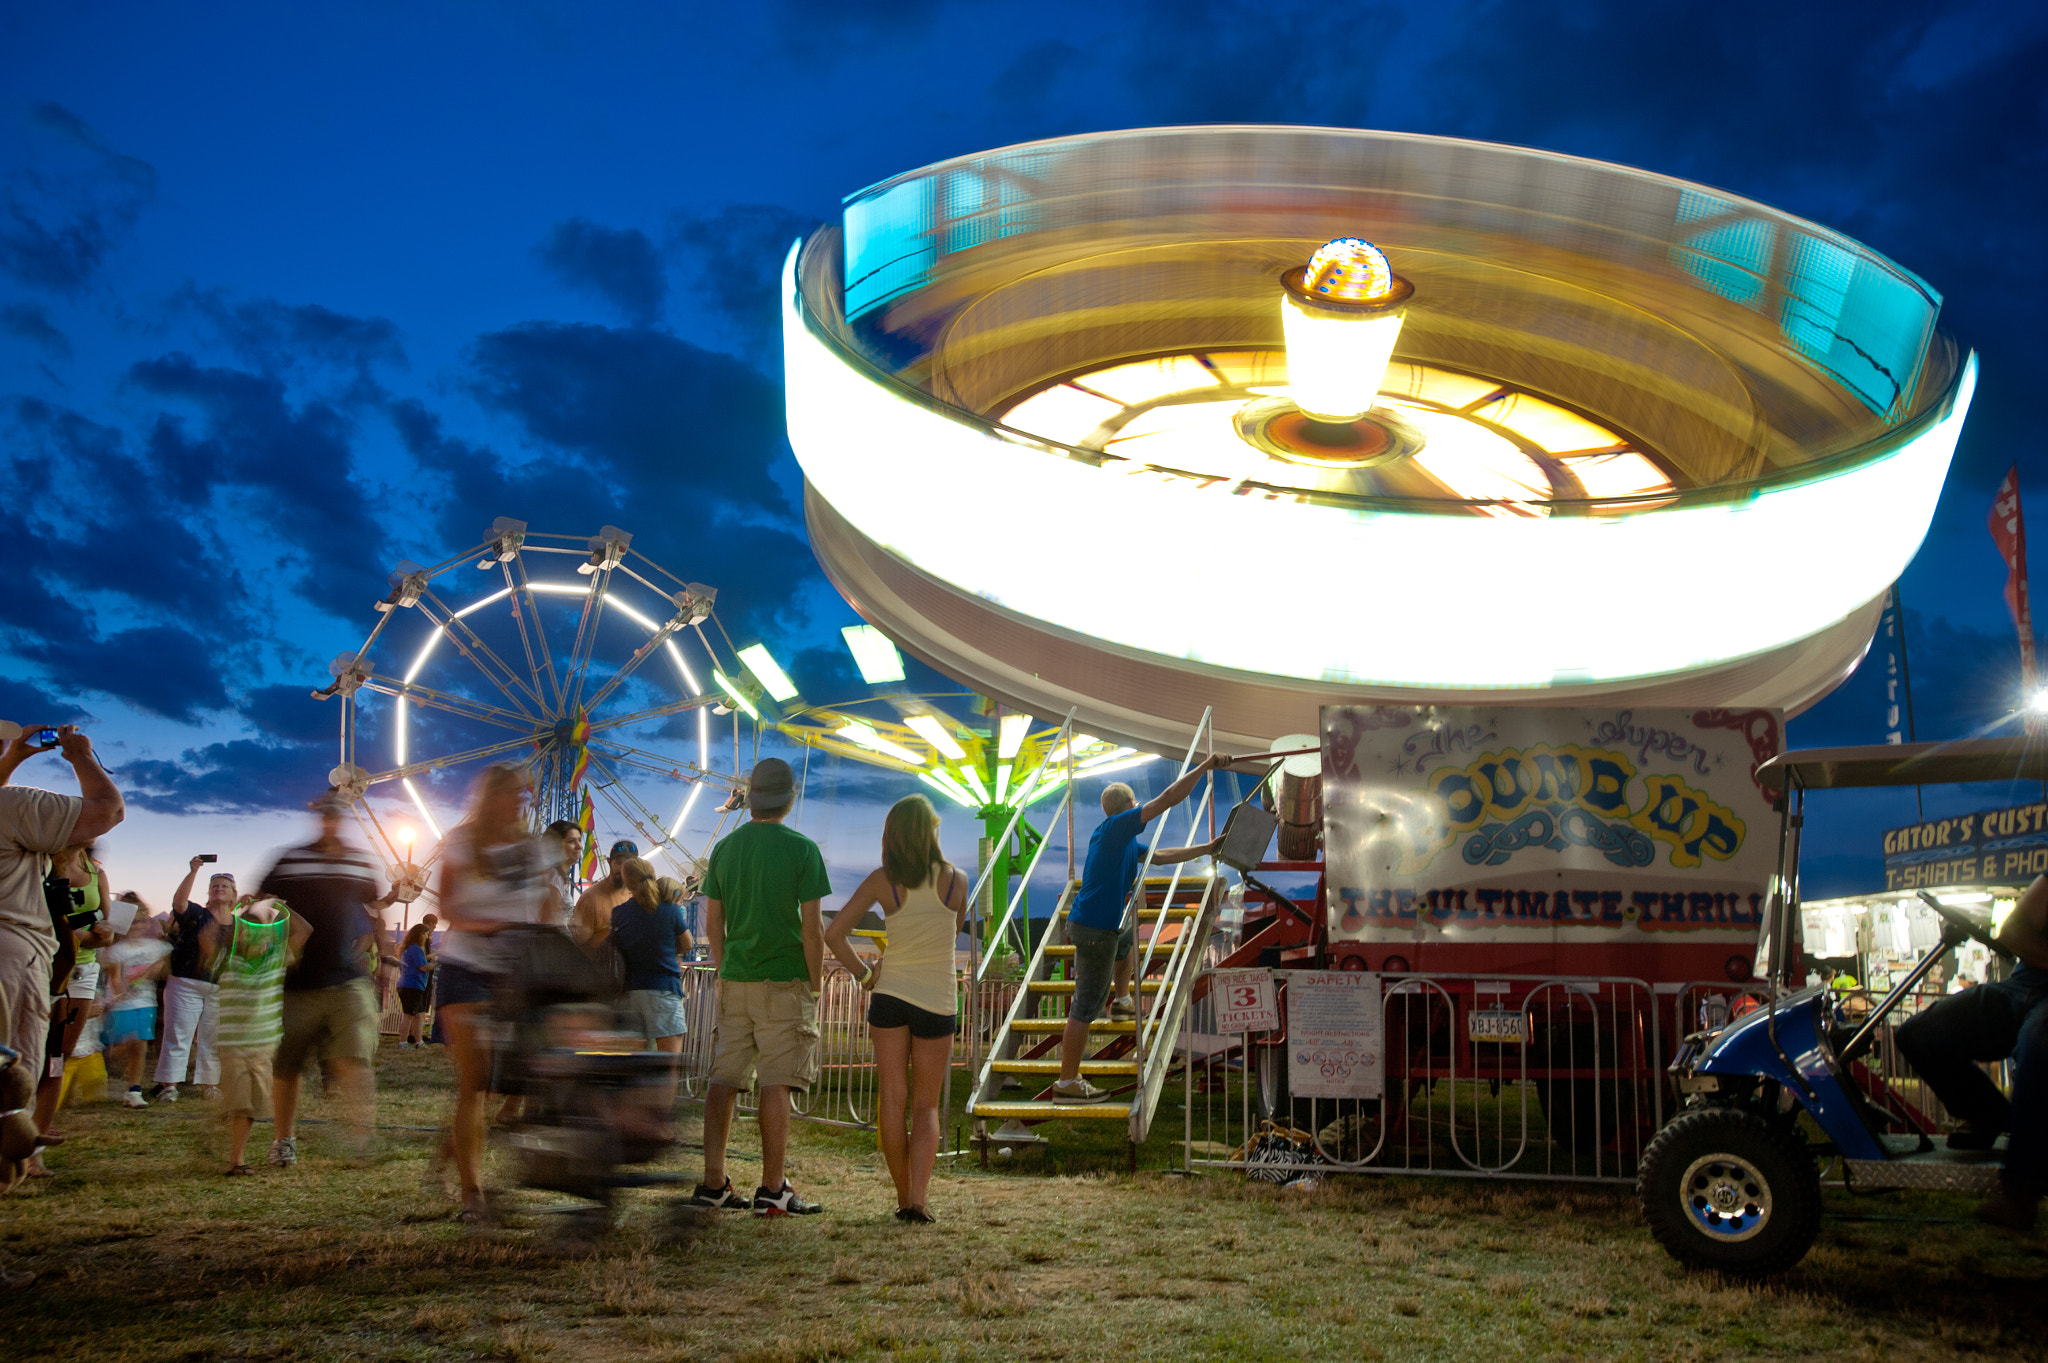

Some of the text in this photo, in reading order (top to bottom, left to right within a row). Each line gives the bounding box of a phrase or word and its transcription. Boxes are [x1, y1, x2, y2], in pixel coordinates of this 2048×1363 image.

[1403, 720, 1497, 772] The
[1590, 709, 1710, 775] Super
[1630, 774, 1746, 868] UP
[1884, 804, 2048, 855] GATOR'S CUST
[1886, 858, 1978, 890] T-SHIRTS
[1983, 855, 1997, 878] &
[1340, 888, 1417, 932] THE
[1425, 889, 1623, 930] ULTIMATE
[1216, 972, 1270, 985] THIS RIDE TAKES
[1234, 987, 1257, 1006] 3
[1306, 974, 1362, 986] SAFETY
[1219, 1010, 1273, 1023] TICKETS
